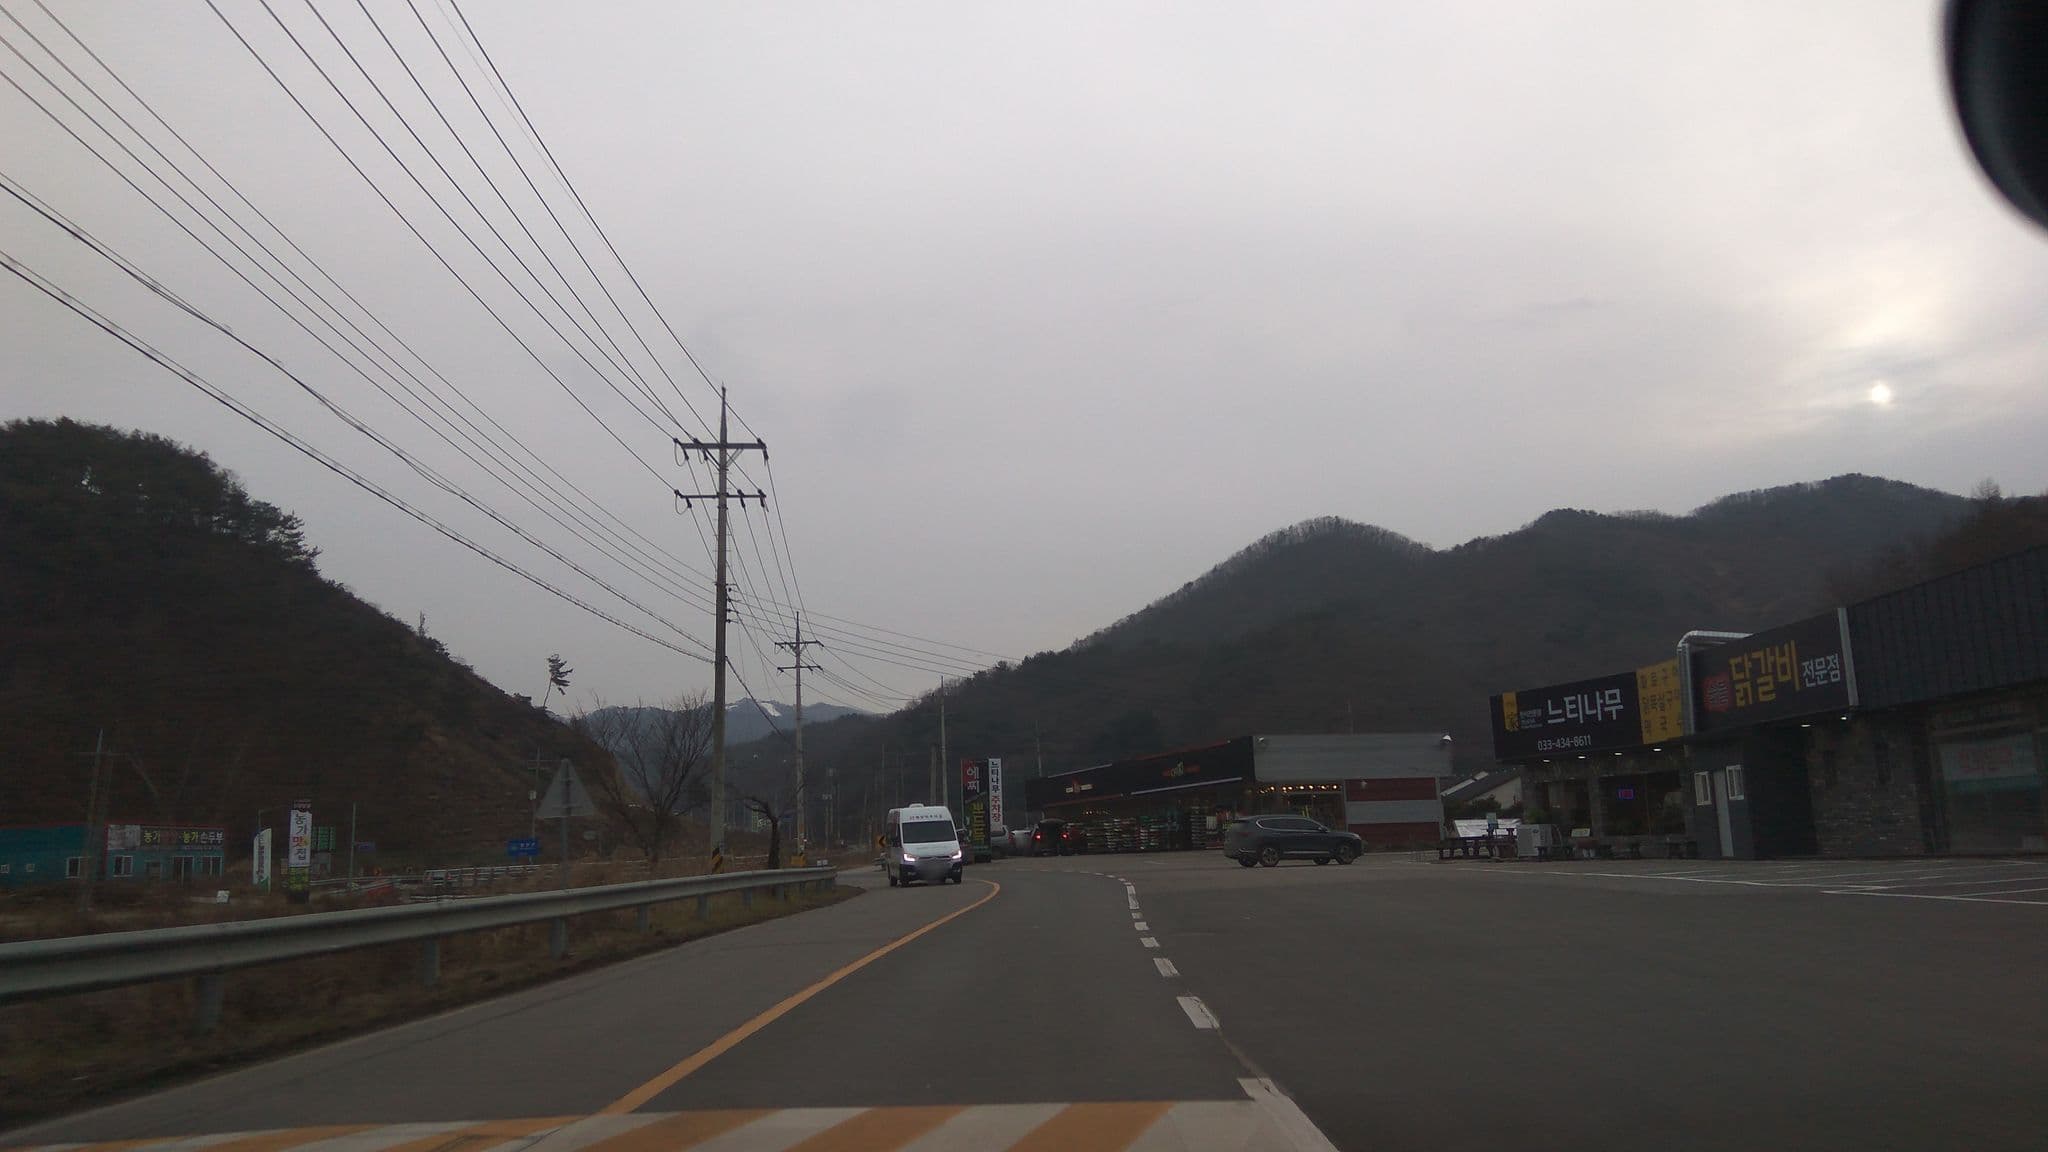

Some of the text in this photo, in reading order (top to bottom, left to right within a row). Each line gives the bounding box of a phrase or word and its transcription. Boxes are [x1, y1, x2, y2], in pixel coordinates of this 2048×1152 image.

[1728, 640, 1801, 707] 닭갈비
[1801, 653, 1840, 687] 전문점
[1547, 688, 1624, 724] 느티나무
